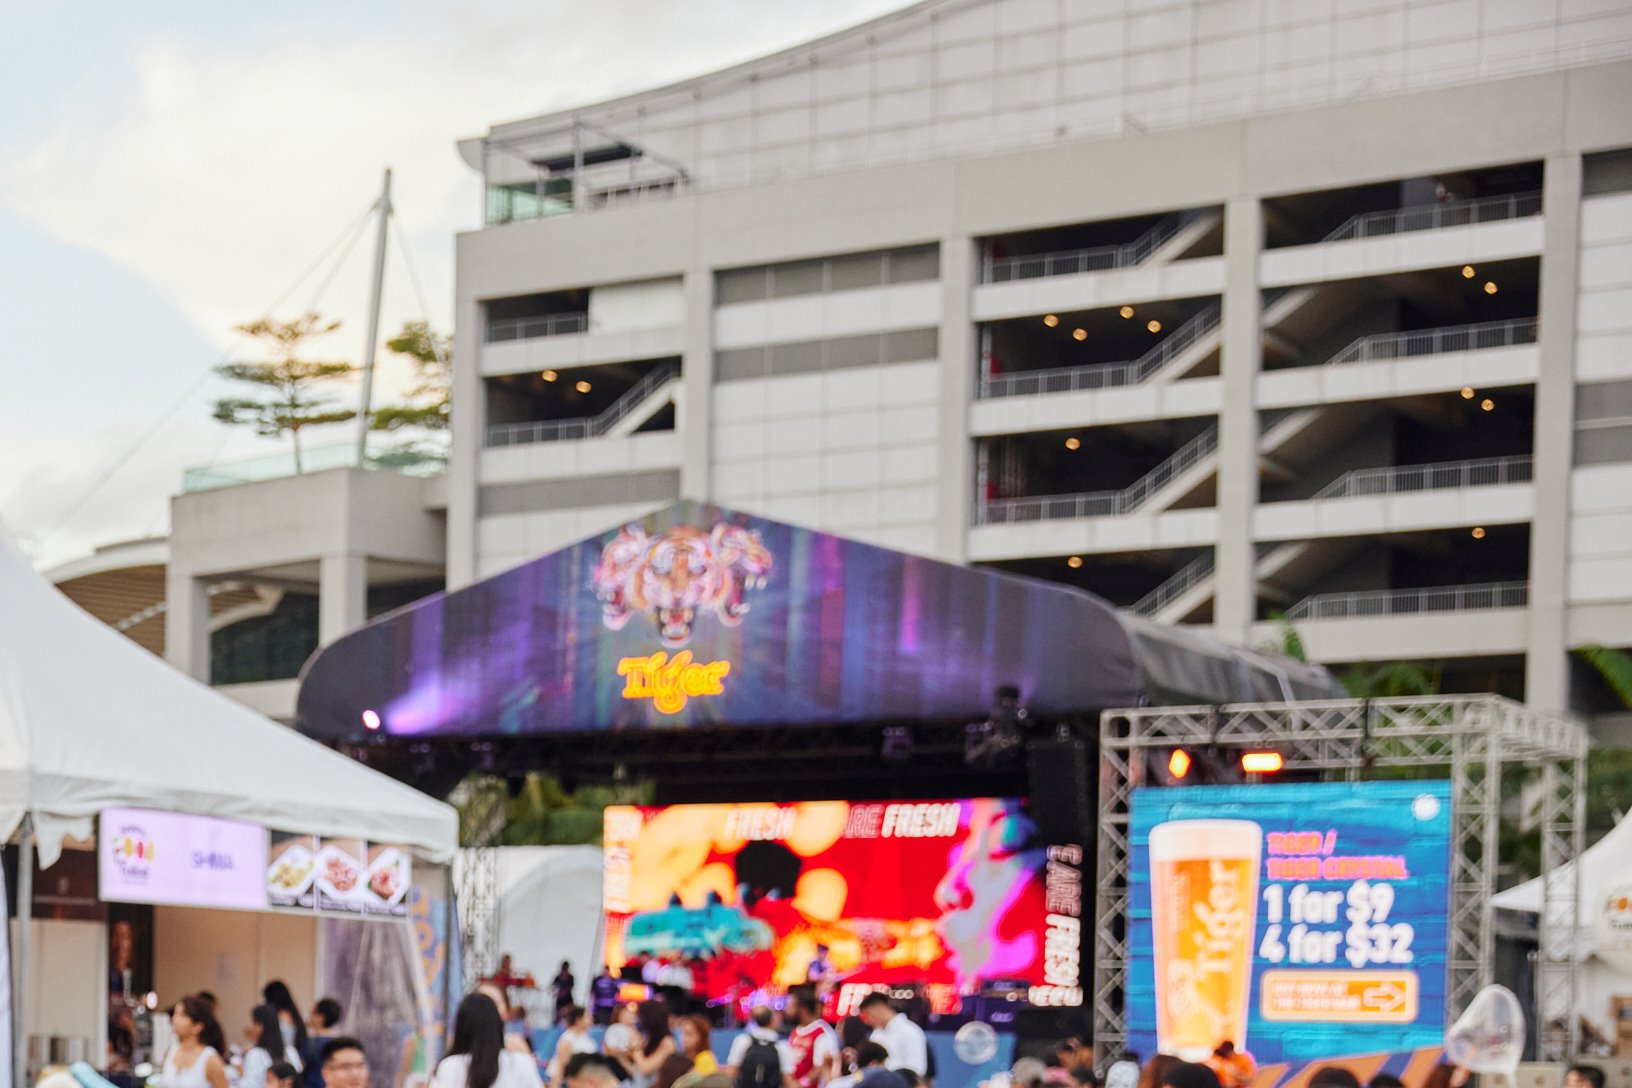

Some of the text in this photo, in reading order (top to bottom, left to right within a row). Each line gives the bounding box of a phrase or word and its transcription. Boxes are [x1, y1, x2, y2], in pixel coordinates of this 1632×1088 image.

[617, 650, 730, 714] Tiger
[881, 803, 962, 838] FRESH
[1263, 879, 1395, 924] 1 for $9
[1044, 913, 1081, 987] FRESH
[1259, 921, 1415, 968] 4 for $32
